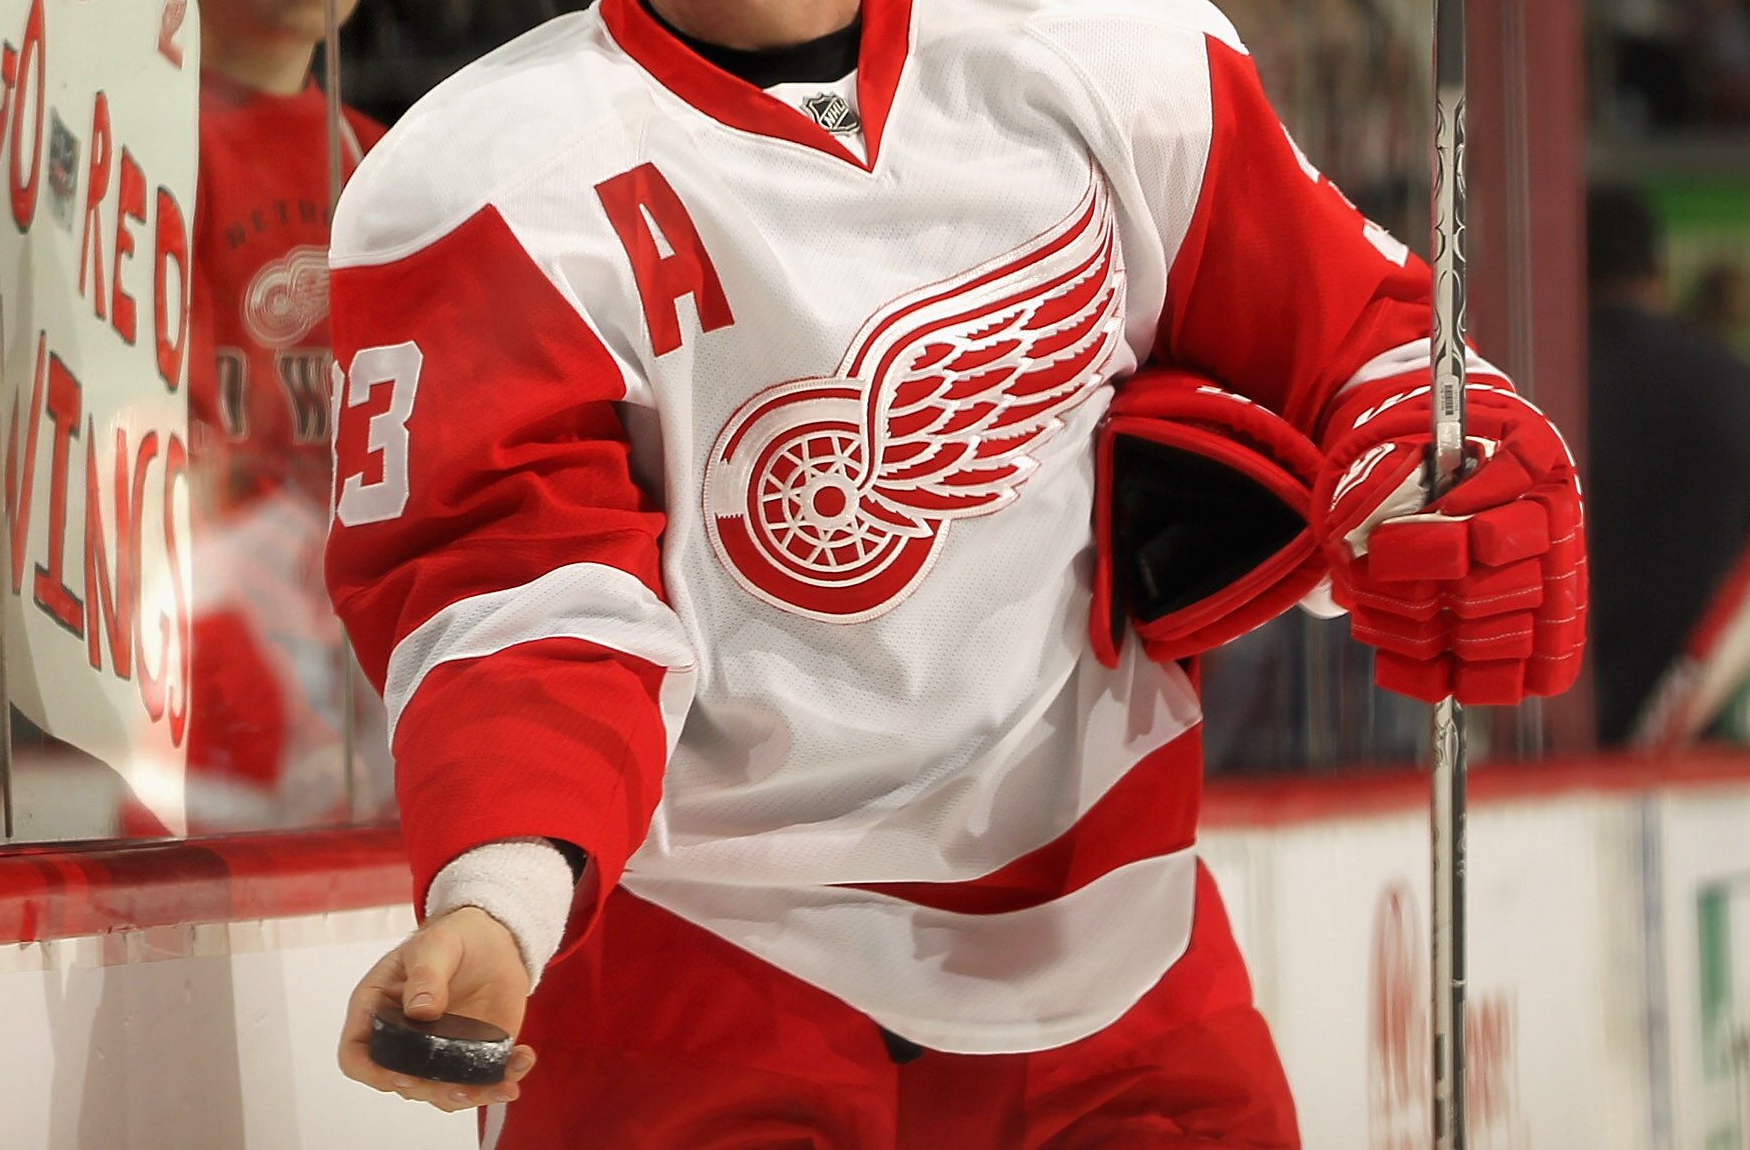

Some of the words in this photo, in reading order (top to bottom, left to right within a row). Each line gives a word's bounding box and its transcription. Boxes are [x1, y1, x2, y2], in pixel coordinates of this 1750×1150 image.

[78, 89, 188, 393] RED
[594, 161, 736, 357] A
[330, 340, 423, 528] 3
